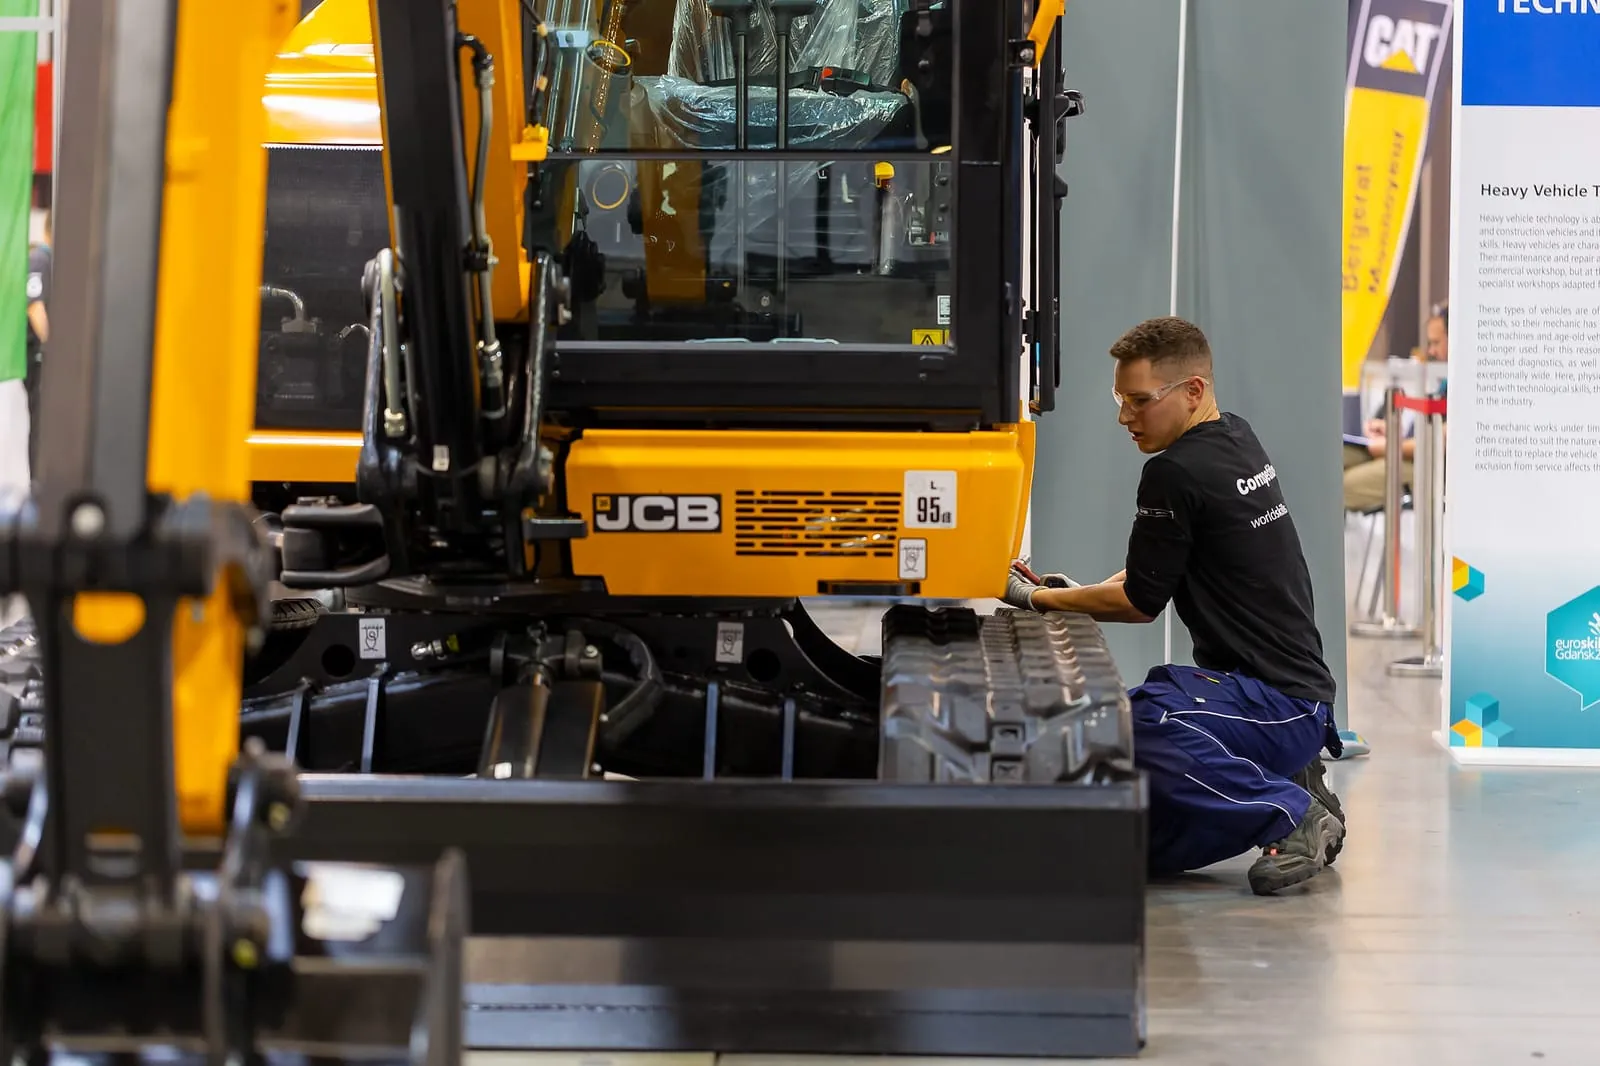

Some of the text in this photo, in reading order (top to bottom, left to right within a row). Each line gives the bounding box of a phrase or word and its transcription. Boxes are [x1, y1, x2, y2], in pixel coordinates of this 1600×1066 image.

[1364, 14, 1441, 75] CAT
[1481, 184, 1528, 200] Heavy
[1533, 184, 1588, 197] Vehicle
[1480, 214, 1504, 225] Heavy
[1506, 214, 1534, 223] vehicle
[1536, 215, 1580, 226] technology
[1583, 215, 1588, 223] is
[1480, 228, 1494, 236] and
[1496, 228, 1544, 236] construction
[1546, 228, 1578, 236] vehicles
[1580, 228, 1594, 237] and
[1502, 241, 1526, 252] Heavy
[1480, 253, 1498, 261] Their
[1500, 253, 1552, 262] maintenance
[1554, 253, 1568, 262] and
[1571, 254, 1594, 265] repair
[1479, 266, 1524, 275] commercial
[1569, 267, 1582, 275] but
[1585, 267, 1593, 275] at
[1478, 280, 1514, 291] specialist
[1517, 280, 1560, 291] workshops
[1562, 280, 1595, 292] adapted
[1478, 305, 1500, 314] These
[1504, 305, 1525, 317] types
[1528, 306, 1537, 314] of
[1540, 306, 1572, 314] vehicles
[1522, 319, 1540, 327] their
[1544, 319, 1580, 328] mechanic
[1583, 319, 1597, 328] has
[1478, 331, 1494, 340] tech
[1497, 332, 1534, 340] machines
[1537, 332, 1552, 340] and
[1490, 345, 1516, 355] longer
[1477, 358, 1514, 366] advanced
[1580, 359, 1597, 367] well
[1476, 371, 1528, 382] exceptionally
[1476, 384, 1496, 392] hand
[1498, 384, 1516, 392] with
[1517, 385, 1570, 395] technological
[1476, 422, 1490, 431] The
[1493, 423, 1530, 431] mechanic
[1534, 423, 1557, 431] works
[1561, 424, 1584, 432] under
[1476, 435, 1496, 444] often
[1498, 436, 1527, 444] created
[1530, 436, 1538, 444] to
[1540, 436, 1554, 444] suit
[1556, 436, 1568, 445] the
[1571, 436, 1596, 445] nature
[1524, 449, 1553, 460] replace
[1475, 462, 1511, 470] exclusion
[1514, 462, 1532, 470] from
[1535, 462, 1562, 471] service
[1564, 463, 1590, 471] affects
[596, 496, 720, 531] JCB
[918, 497, 940, 523] 95
